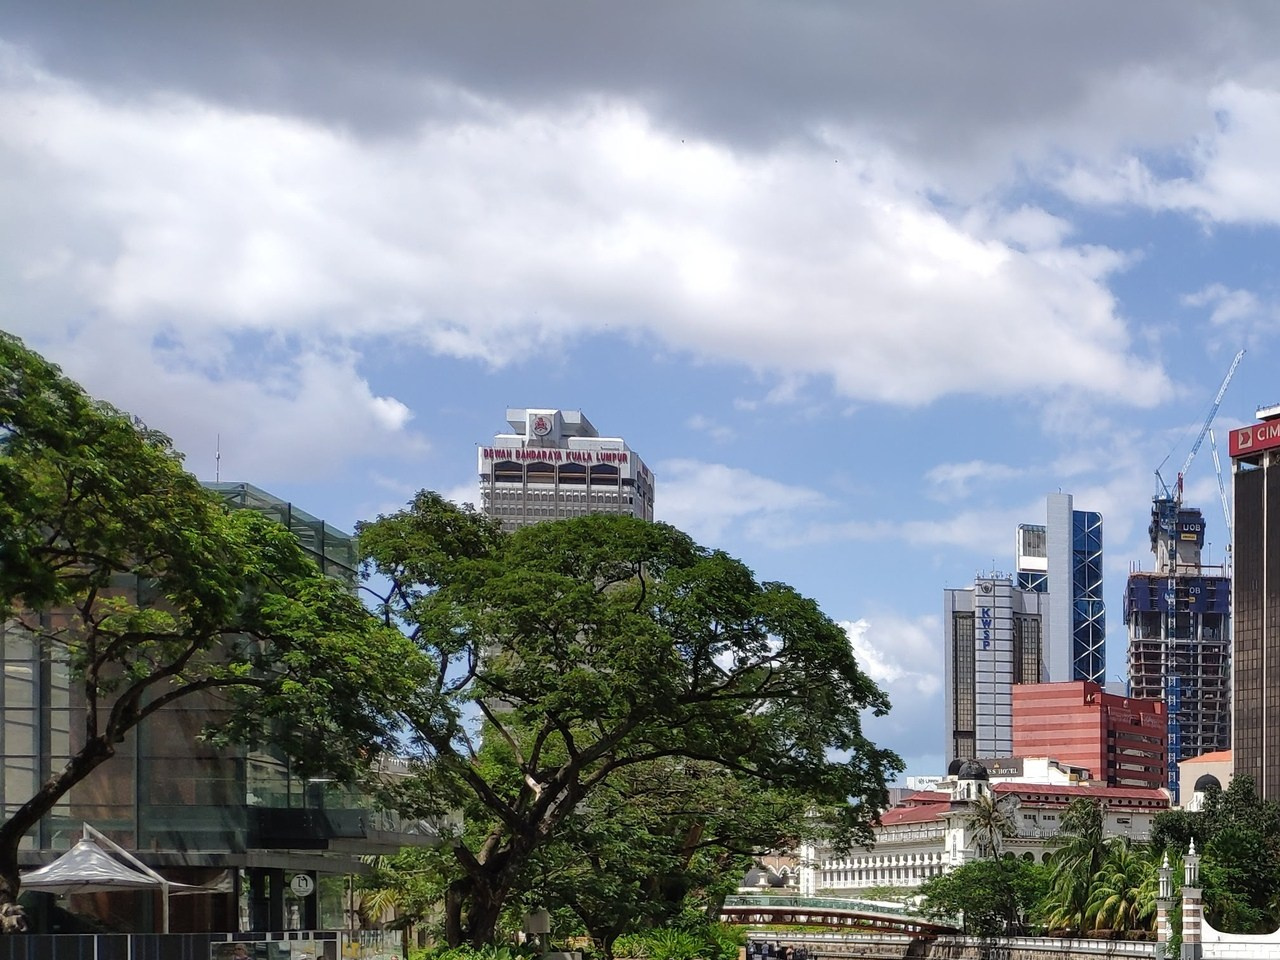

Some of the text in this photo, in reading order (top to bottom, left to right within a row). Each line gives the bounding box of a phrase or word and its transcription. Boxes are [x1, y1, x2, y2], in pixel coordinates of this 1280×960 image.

[484, 448, 628, 464] DEWAN BANDARAYA KUALA LUMPUR
[981, 607, 992, 650] KWSP
